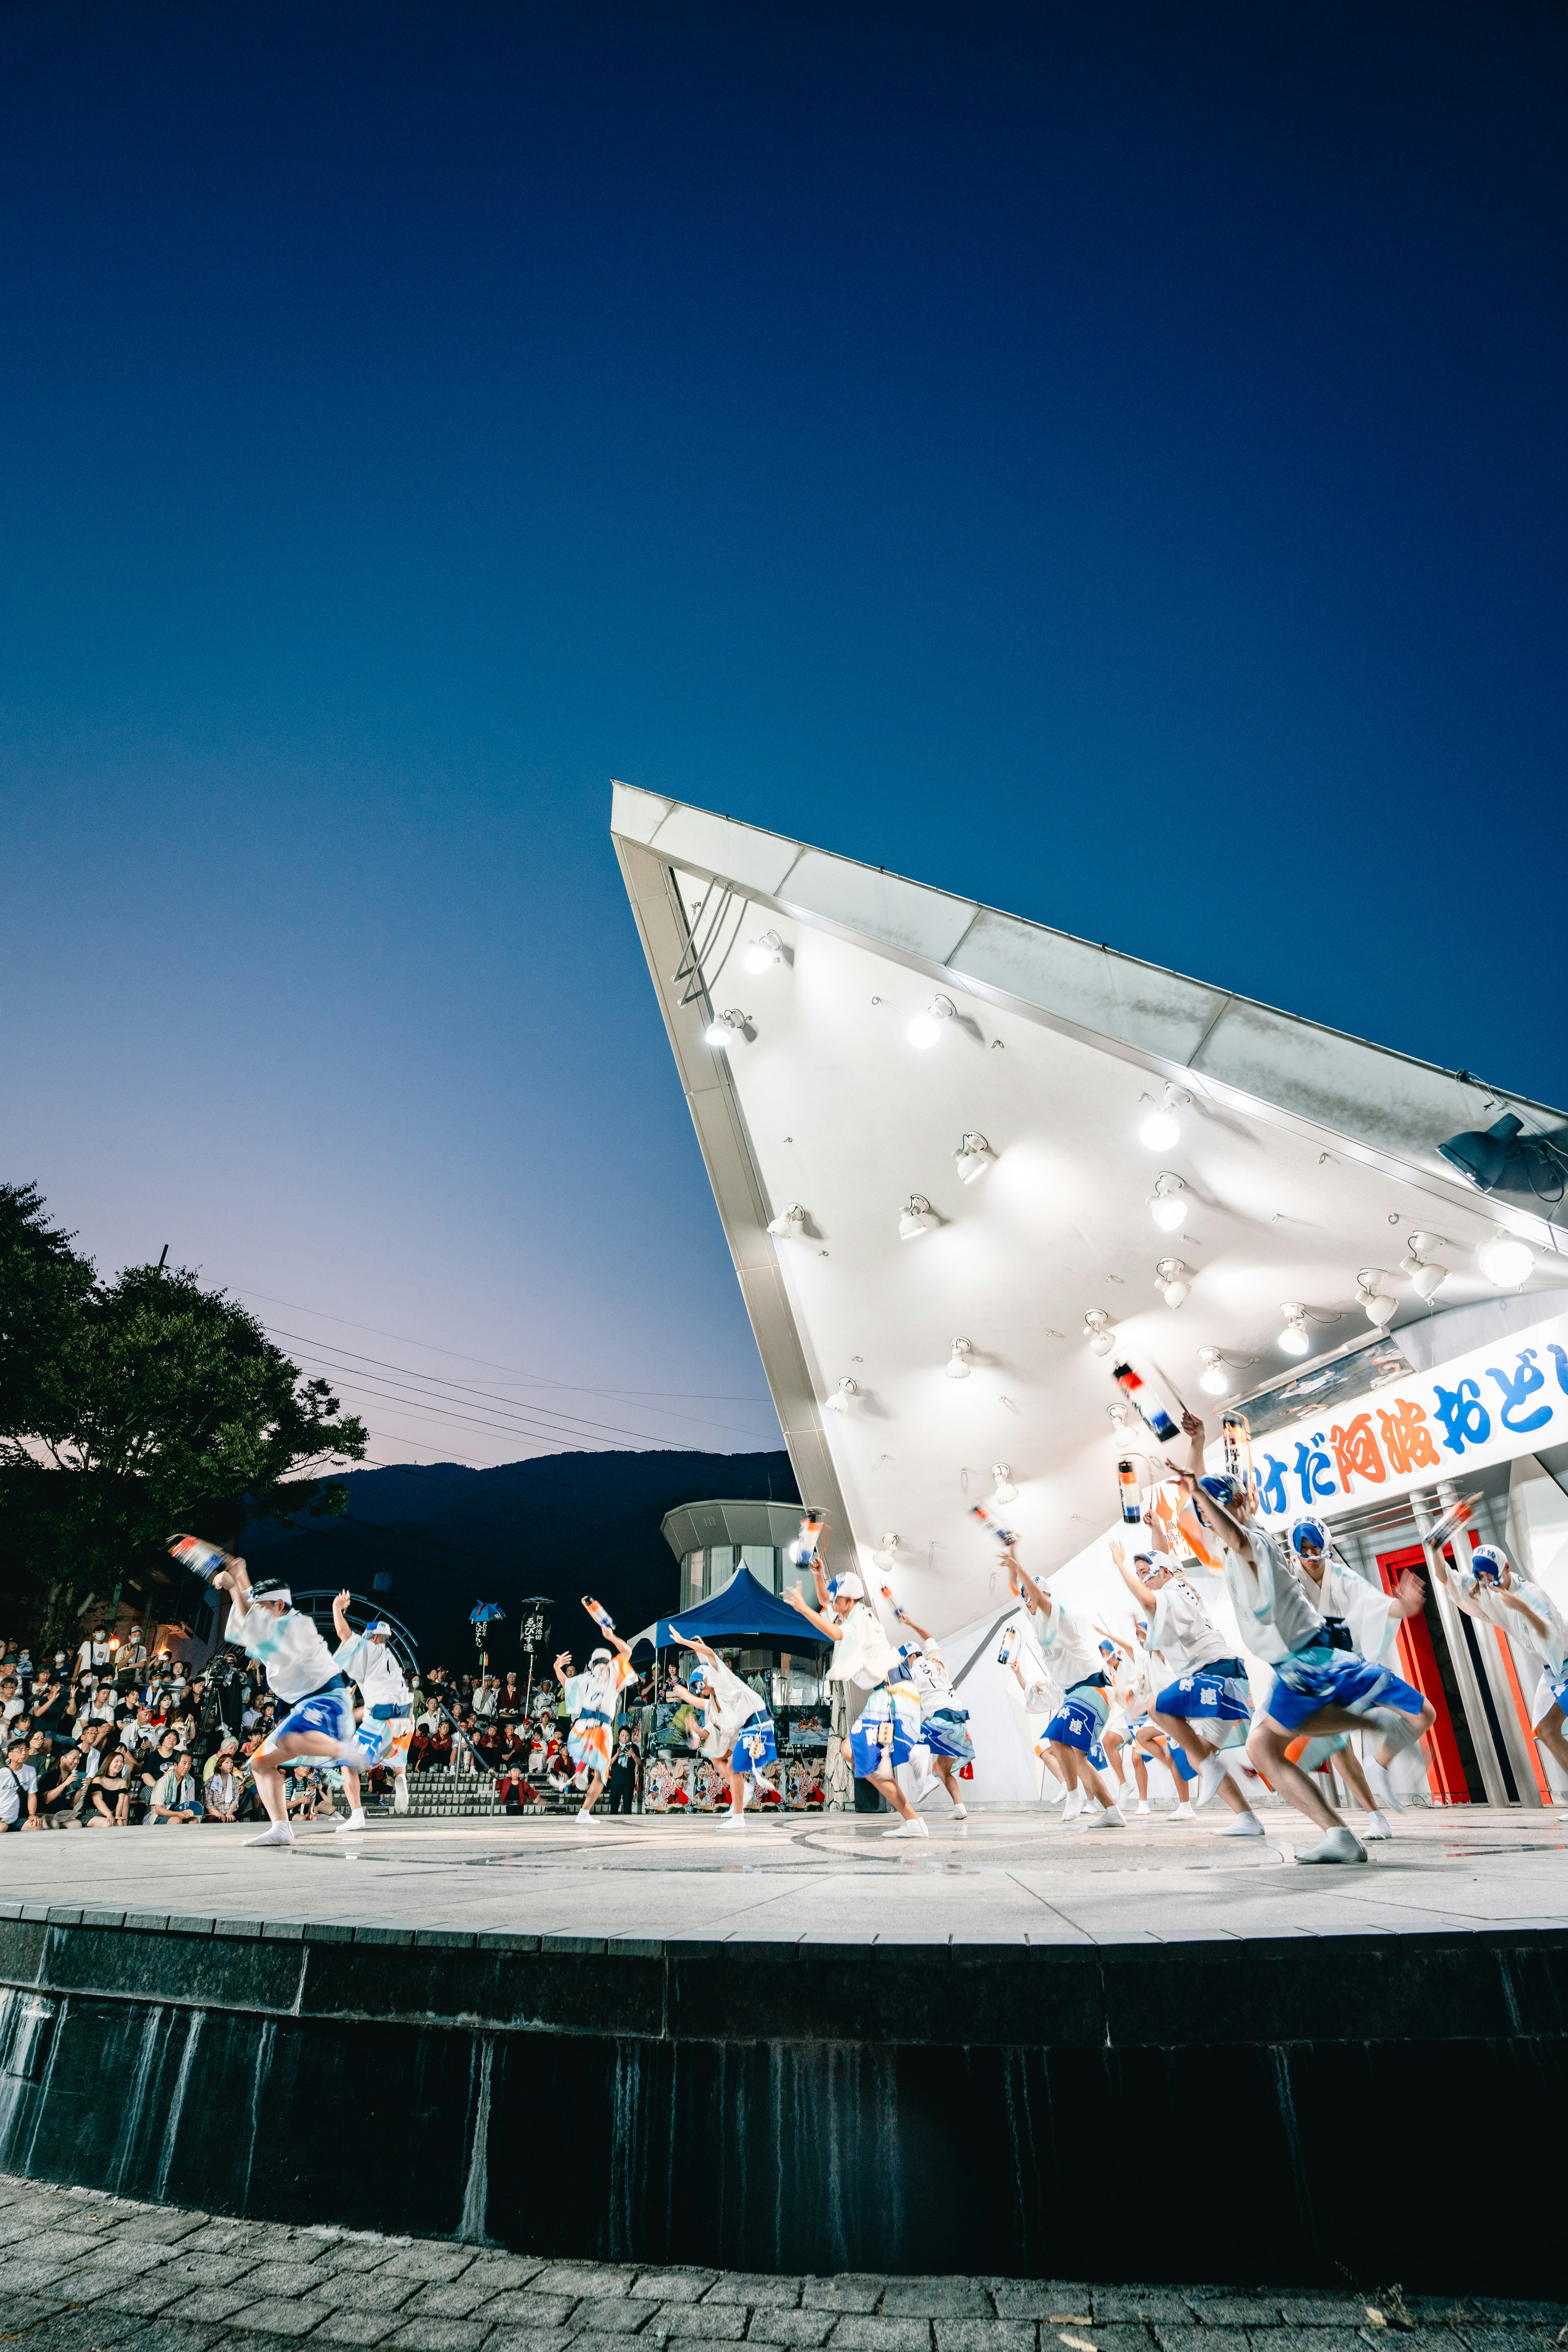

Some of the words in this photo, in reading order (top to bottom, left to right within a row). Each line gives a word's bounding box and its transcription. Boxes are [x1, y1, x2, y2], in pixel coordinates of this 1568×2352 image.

[523, 1617, 536, 1653] ゑびす連
[535, 1615, 544, 1640] 阿波池田
[662, 1770, 670, 1809] 阿波おどり
[708, 1770, 717, 1809] 阿波おどり
[800, 1769, 808, 1807] 阿波おどり
